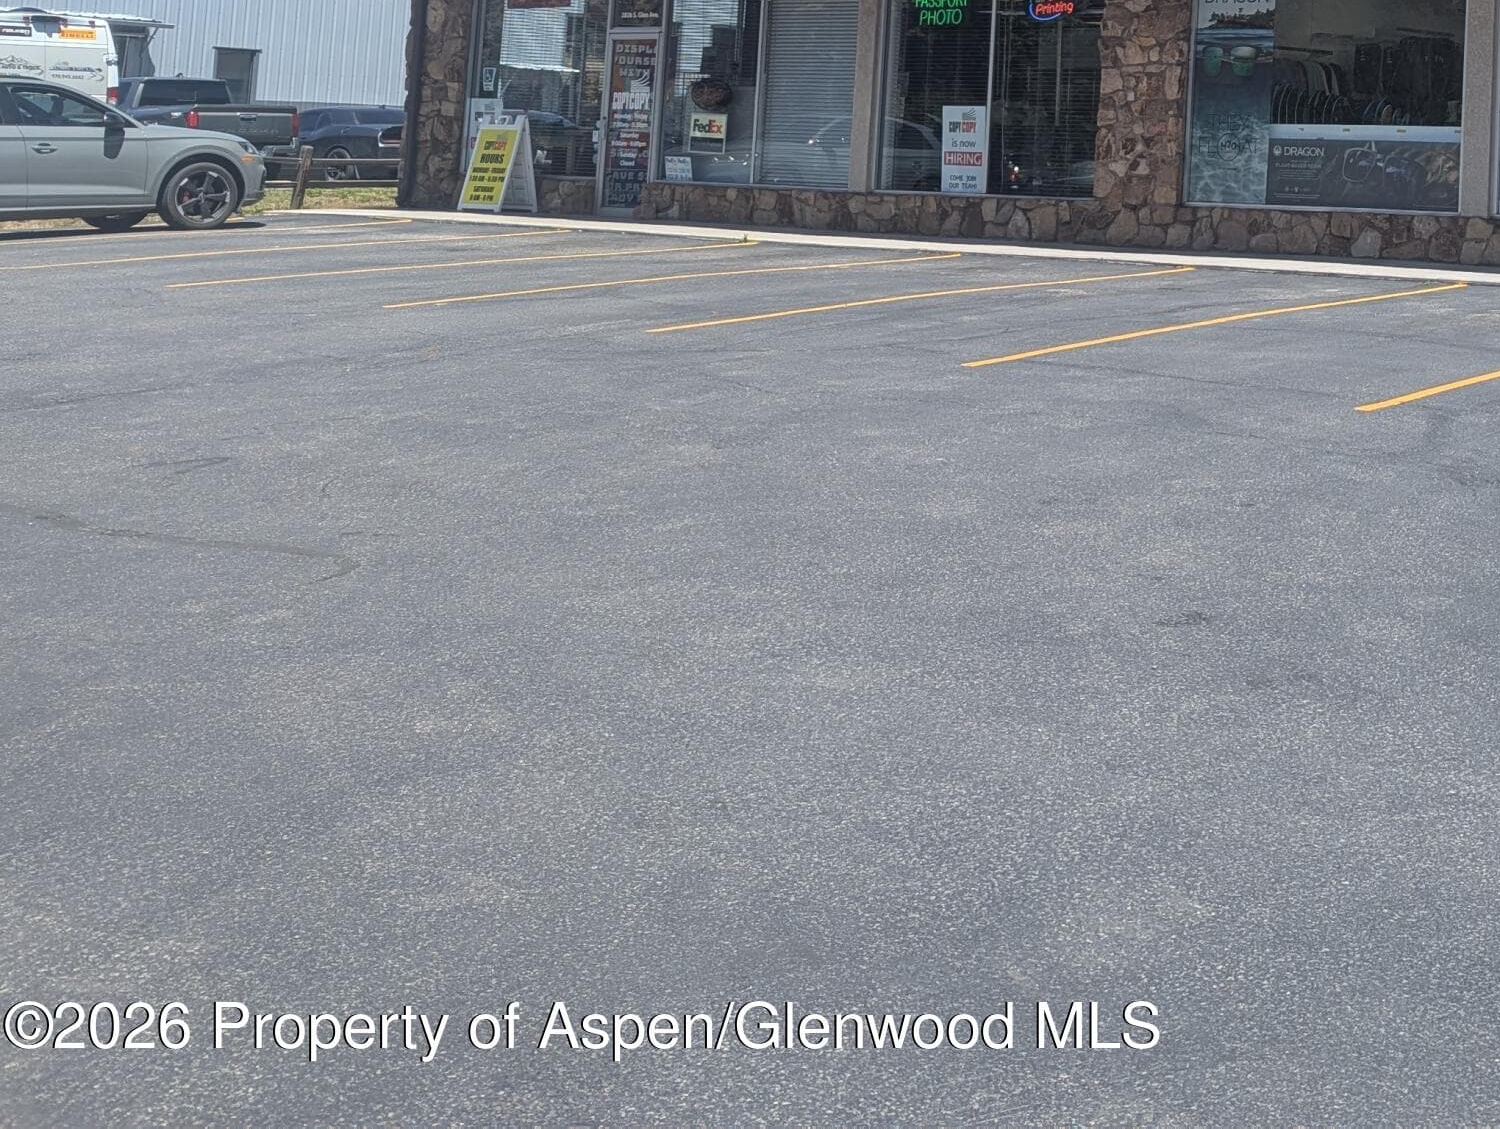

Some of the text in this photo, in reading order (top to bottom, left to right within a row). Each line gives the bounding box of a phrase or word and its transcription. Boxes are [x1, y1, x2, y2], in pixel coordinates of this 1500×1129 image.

[1035, 1, 1074, 15] Printing
[919, 9, 962, 25] PHOTO
[693, 119, 723, 134] FedEx
[952, 138, 958, 147] is
[1284, 146, 1325, 157] DRAGON
[480, 154, 504, 164] HOURS
[946, 152, 982, 165] HIRING
[949, 174, 963, 182] COME
